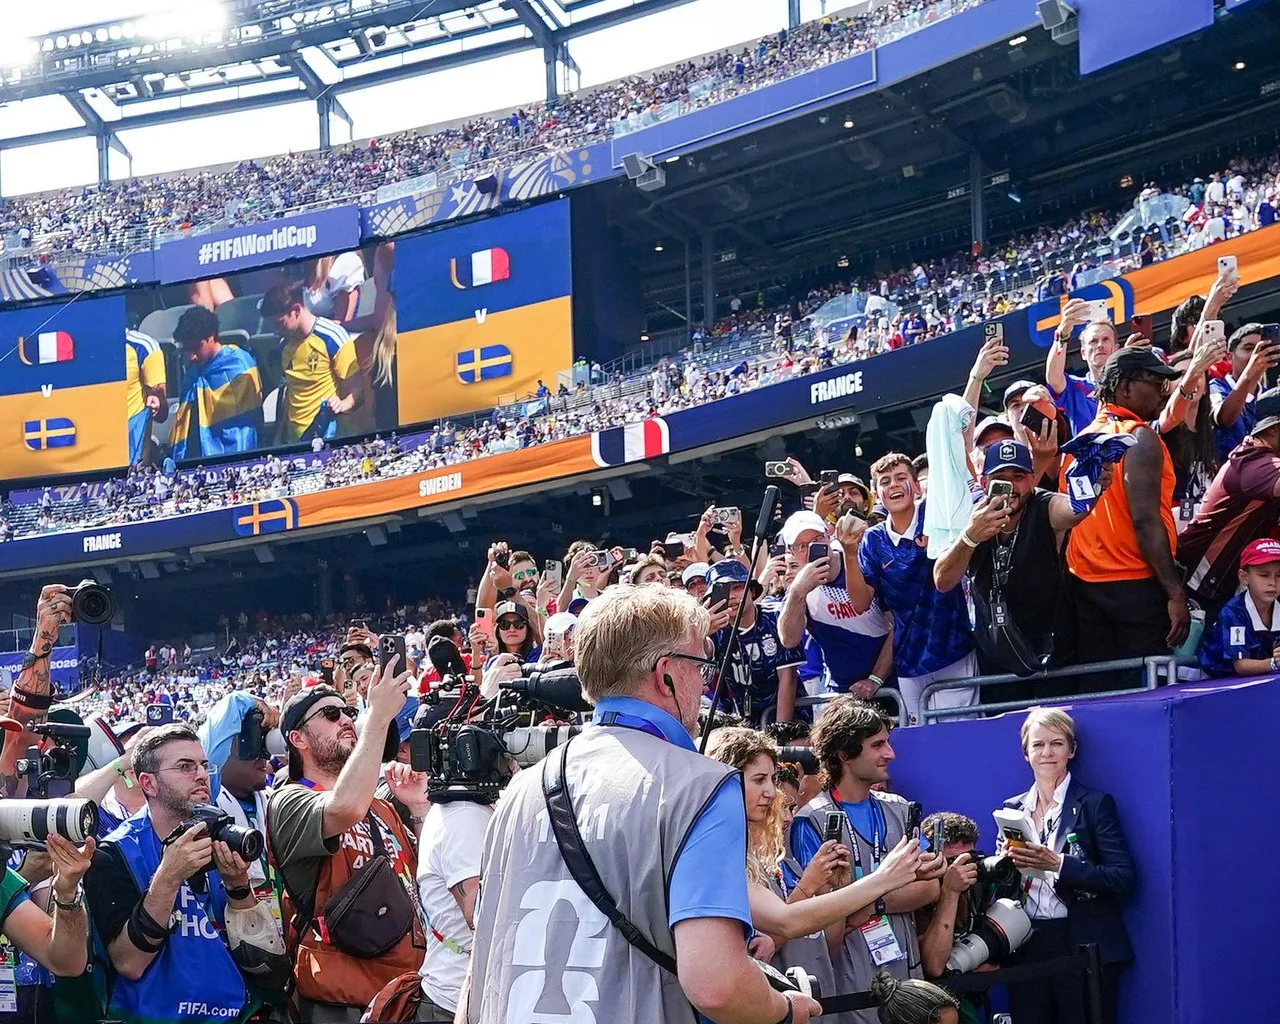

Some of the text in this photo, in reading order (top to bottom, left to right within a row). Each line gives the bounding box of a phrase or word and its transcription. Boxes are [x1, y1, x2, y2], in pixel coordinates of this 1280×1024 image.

[198, 224, 318, 266] #FIFAWorldCup
[811, 370, 863, 404] FRANCE
[419, 471, 462, 497] SWEDEN
[83, 532, 122, 553] FRANCE
[50, 658, 78, 670] 2026
[178, 1001, 240, 1017] FIFA.com
